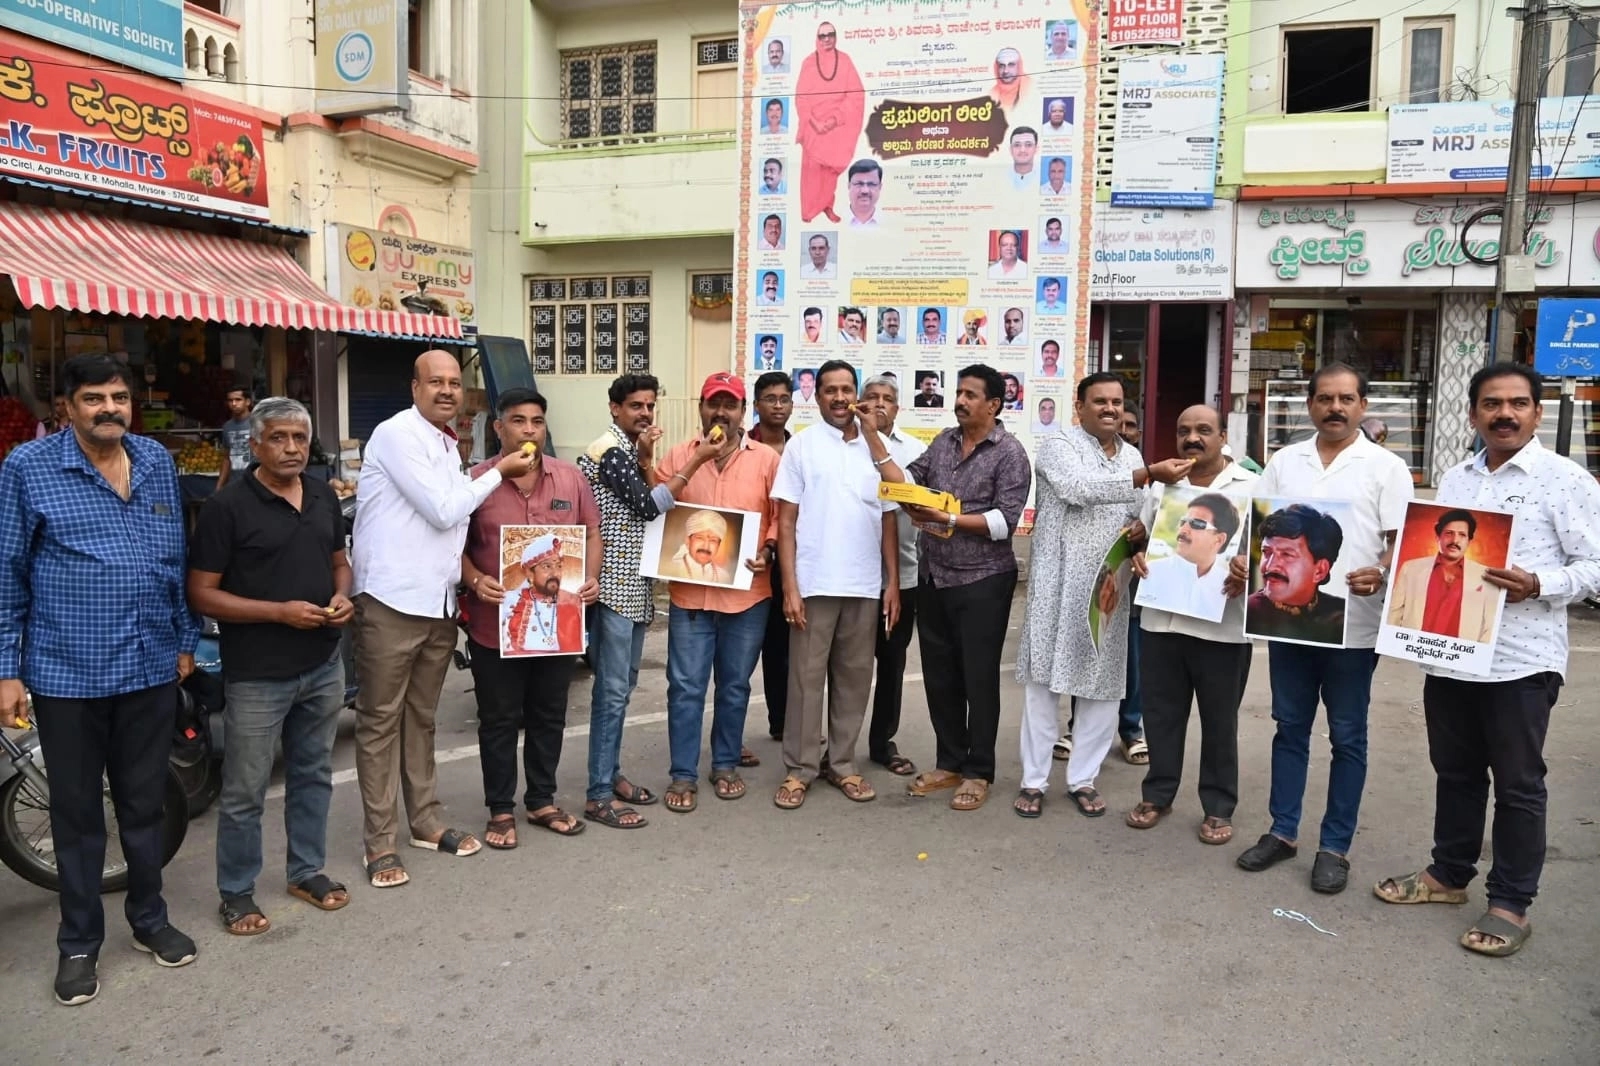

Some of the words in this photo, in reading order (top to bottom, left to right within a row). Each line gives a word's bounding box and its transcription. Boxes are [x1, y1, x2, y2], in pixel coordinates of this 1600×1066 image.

[1113, 15, 1136, 27] 2ND
[1140, 13, 1177, 26] FLOOR
[123, 27, 176, 56] SOCIETY.
[344, 51, 365, 63] SDM
[1122, 88, 1151, 99] MRJ
[1154, 90, 1217, 99] ASSOCIATES
[881, 105, 952, 130] ಪ್ರಭುಲಿಂಗ
[956, 102, 992, 122] ಲೀಲೆ
[1432, 135, 1475, 152] MRJ
[1480, 136, 1576, 150] ASSATES
[57, 131, 167, 180] FRUITS
[37, 164, 82, 180] Agrahara,
[101, 177, 137, 191] Mohalla,
[138, 183, 166, 197] Mysore
[172, 191, 185, 200] 570
[1259, 207, 1280, 227] ಶ್ರೀ
[1415, 207, 1444, 224] Sri
[1095, 250, 1126, 262] Global
[1129, 249, 1151, 261] Data
[1154, 248, 1215, 263] Solutions(R)
[1270, 230, 1370, 278] ಸ್ವೀಟ್ಸ್
[1403, 227, 1561, 276] Swets
[381, 249, 472, 285] yummy
[401, 271, 457, 288] EXPRESS
[1092, 274, 1109, 284] 2nd
[1112, 273, 1136, 284] Floor
[1417, 636, 1447, 648] ಸಾಹಸ
[1405, 644, 1460, 661] ವಿಷ್ಣುವರ್ಧನ್
